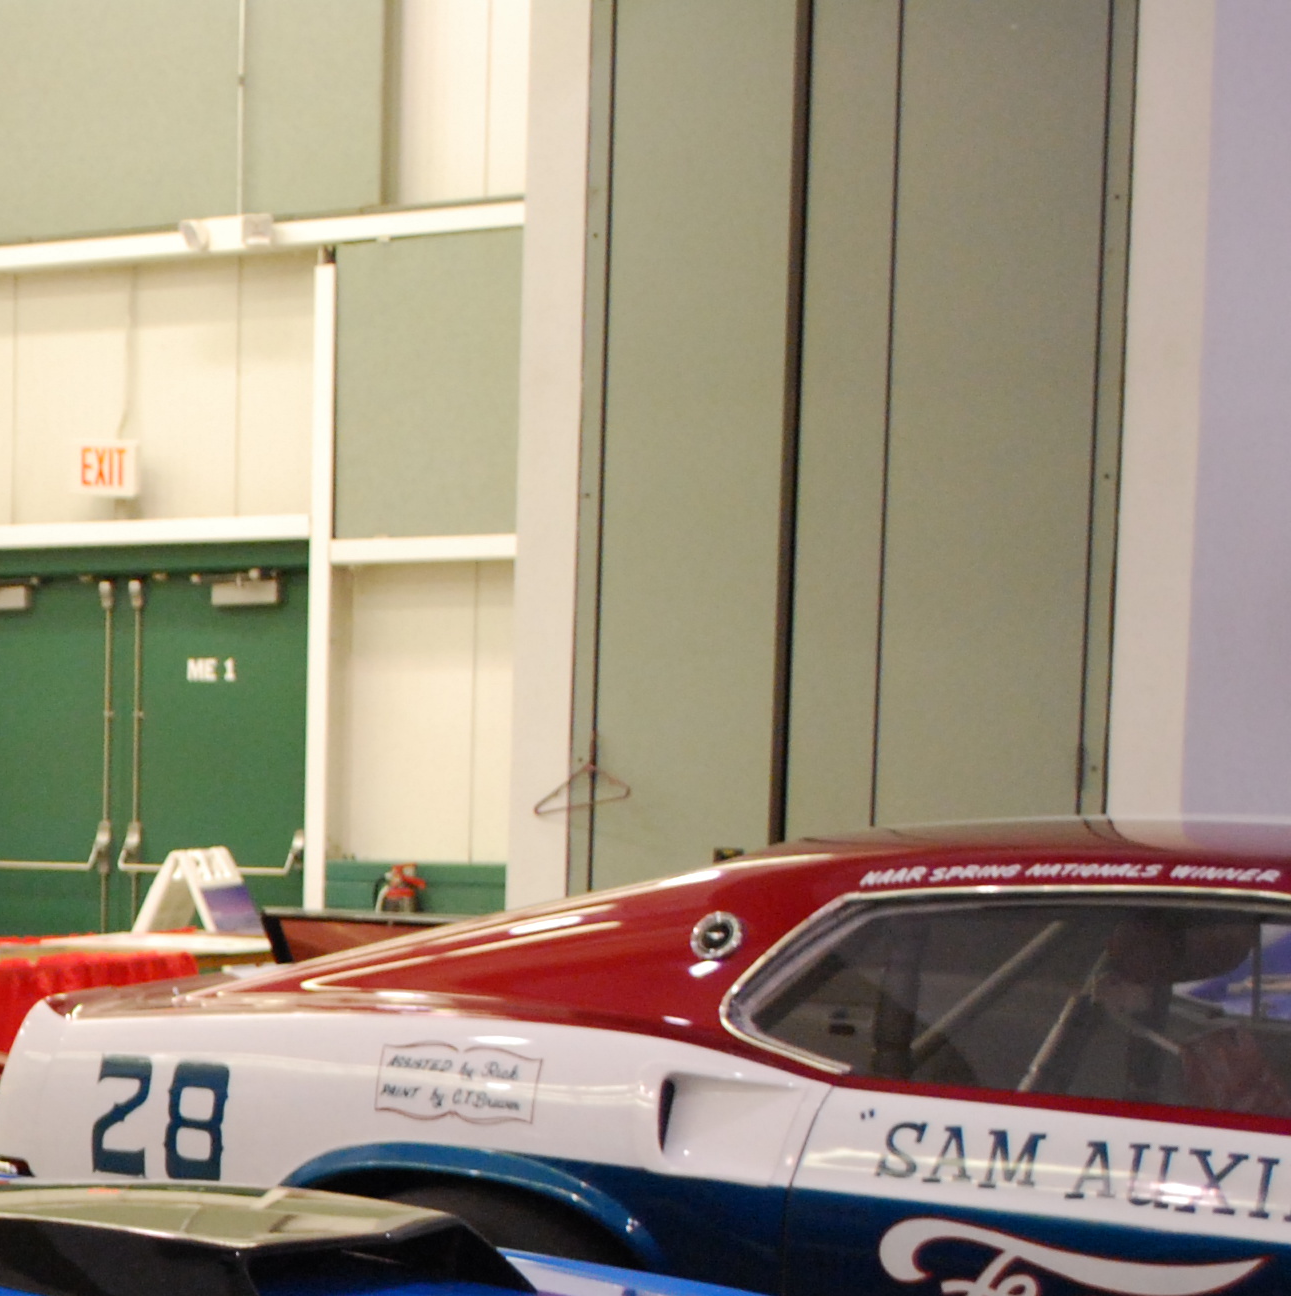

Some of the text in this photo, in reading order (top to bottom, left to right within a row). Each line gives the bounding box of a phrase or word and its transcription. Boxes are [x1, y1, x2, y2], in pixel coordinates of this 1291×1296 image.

[81, 447, 126, 487] EXIT
[186, 657, 236, 682] ME 1
[929, 863, 1022, 882] SPRING
[1025, 863, 1163, 879] NATIONALS
[1169, 864, 1281, 883] WINNER
[380, 1083, 422, 1098] PAINT
[91, 1054, 230, 1180] 28
[1064, 1141, 1291, 1222] AUXI
